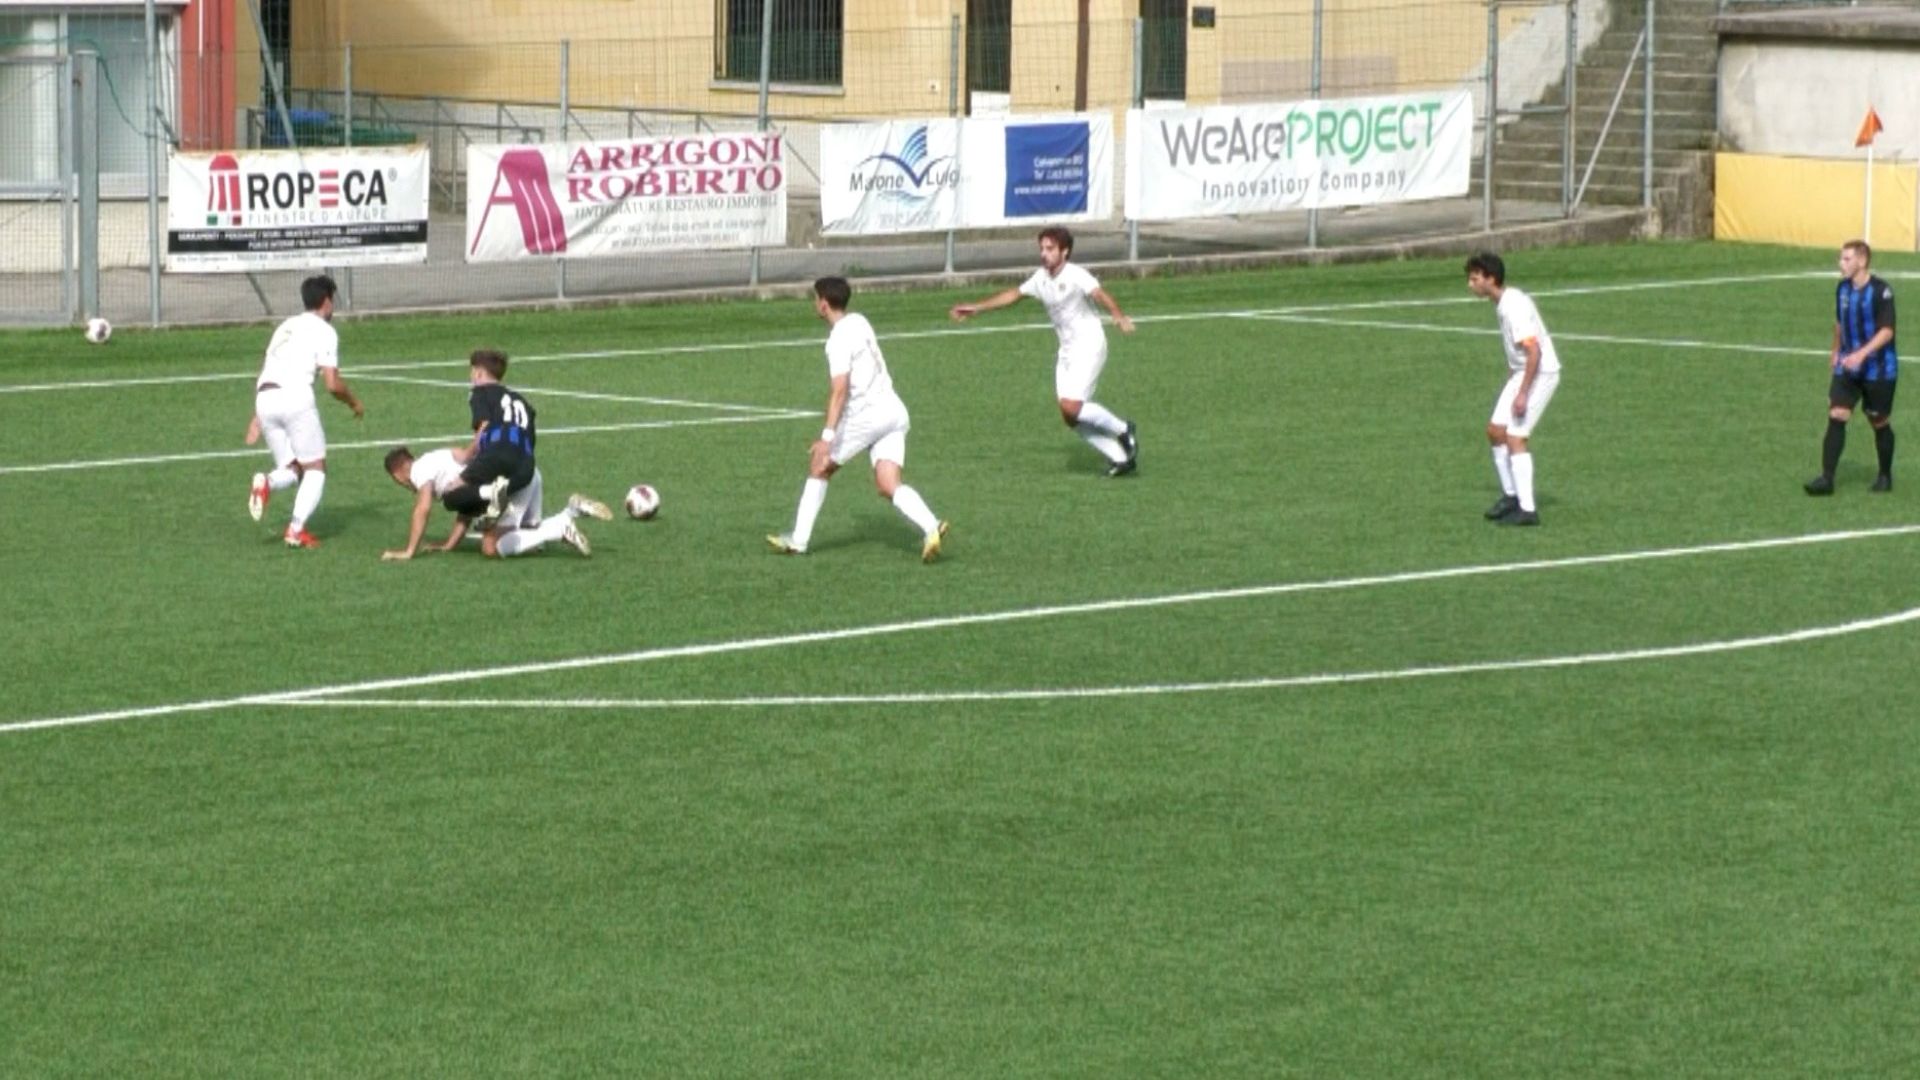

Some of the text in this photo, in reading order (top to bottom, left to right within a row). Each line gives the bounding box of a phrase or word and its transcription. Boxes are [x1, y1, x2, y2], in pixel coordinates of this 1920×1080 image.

[568, 135, 782, 173] ARRIGONI
[567, 166, 782, 203] ROBERTO
[926, 166, 964, 188] Luig
[1202, 169, 1407, 200] Innovation Company
[248, 210, 315, 225] FINESTRE
[501, 393, 528, 429] 10
